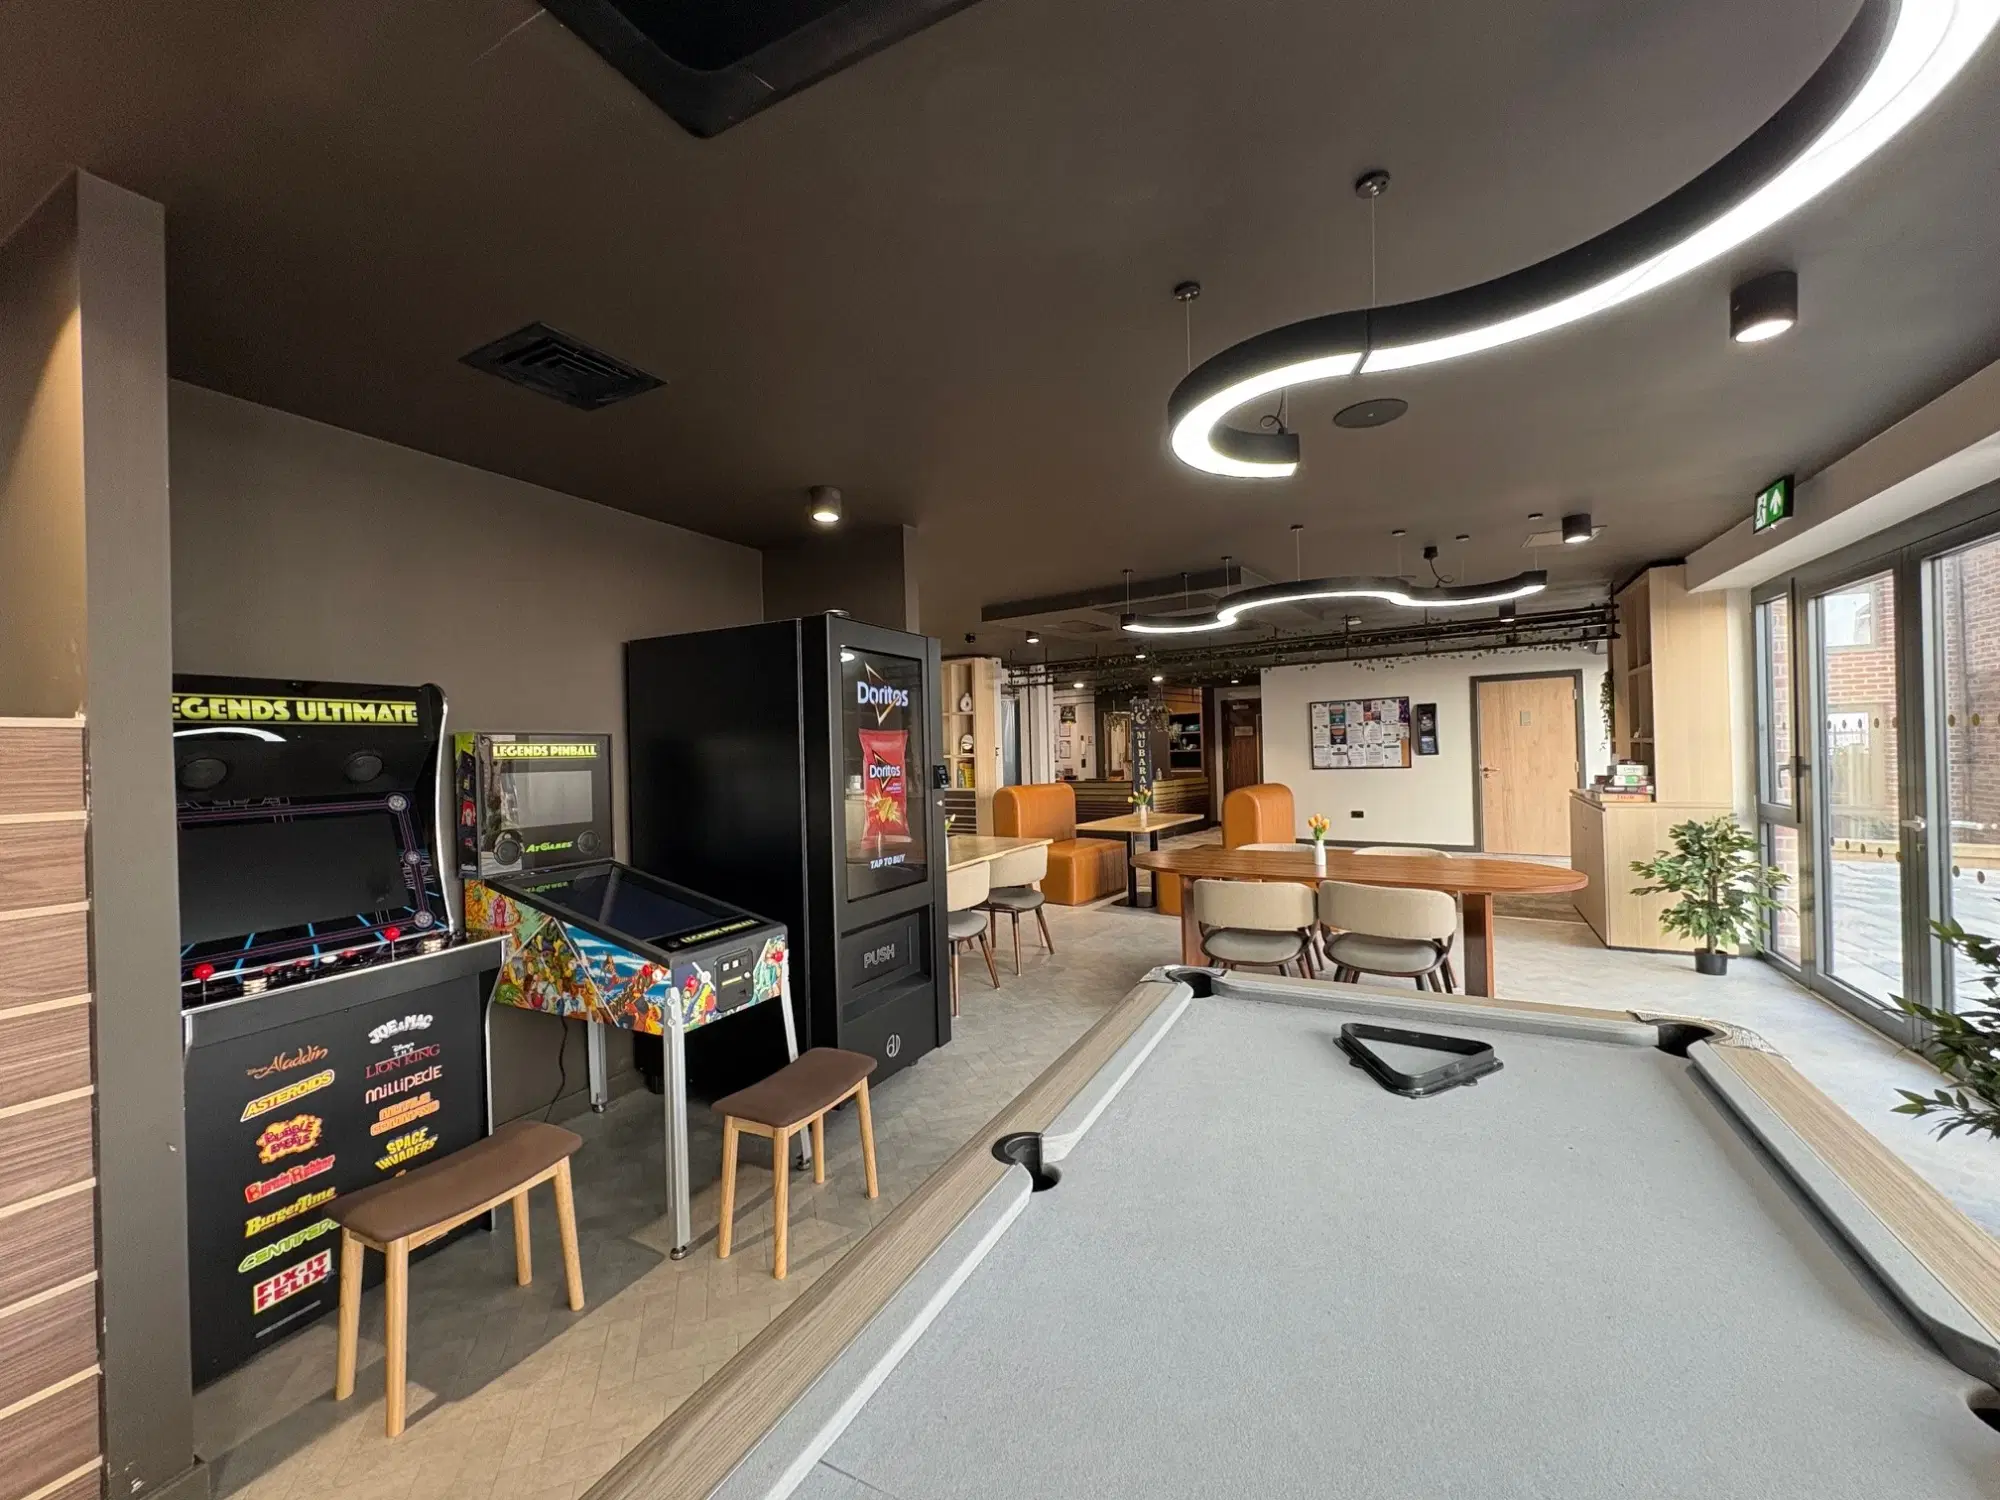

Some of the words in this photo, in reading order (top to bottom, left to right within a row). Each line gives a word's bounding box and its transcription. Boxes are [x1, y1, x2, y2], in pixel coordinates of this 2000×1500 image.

[857, 681, 908, 707] Doritos
[296, 701, 418, 723] ULTIMATE
[493, 745, 549, 757] LEGENDS
[550, 745, 597, 756] PINBALL
[1136, 731, 1147, 793] MUBARAK
[869, 764, 901, 779] Doritos
[870, 857, 883, 870] TAP
[884, 856, 893, 867] TO
[893, 853, 906, 865] BUY
[863, 943, 896, 969] PUSH
[368, 1019, 398, 1044] JOE
[404, 1013, 433, 1031] MAC
[254, 1045, 328, 1079] Aladdin
[365, 1057, 401, 1079] LION
[405, 1044, 440, 1066] KING
[243, 1071, 333, 1119] ASTEROIDS
[375, 1135, 438, 1170] INVADERS
[386, 1126, 428, 1154] SPACE
[238, 1218, 342, 1273] CENTIPED
[257, 1252, 328, 1298] FIX-IT
[257, 1265, 327, 1311] FELIX
